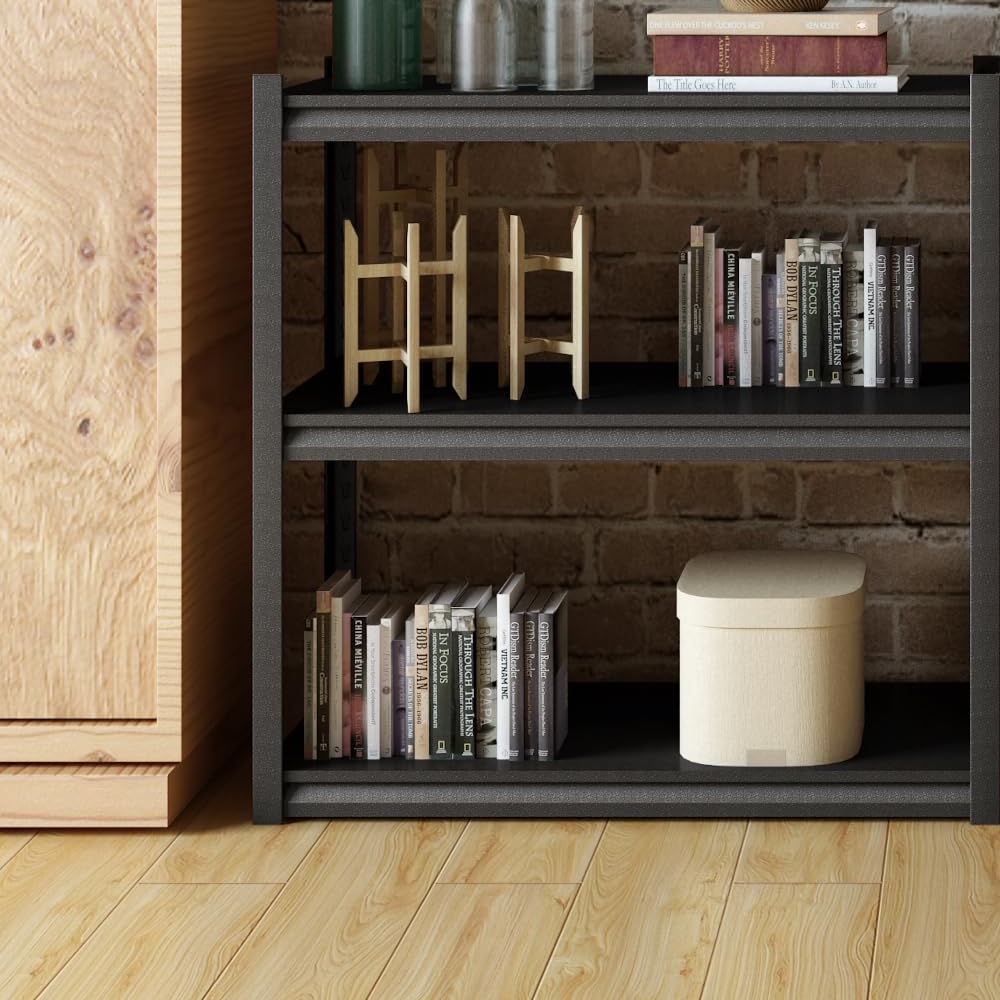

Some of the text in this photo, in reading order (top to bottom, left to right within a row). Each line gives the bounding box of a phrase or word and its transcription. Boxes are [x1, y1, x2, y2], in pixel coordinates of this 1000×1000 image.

[656, 78, 736, 90] The Title Goes Here
[856, 79, 878, 89] Author
[786, 261, 798, 281] BOB
[877, 254, 887, 284] GTDism
[904, 254, 915, 284] GTDism
[727, 253, 737, 319] CHINA MIÉVILLE
[808, 265, 819, 315] IN FOCUS
[867, 281, 875, 315] VIETNAM
[877, 286, 887, 310] Reader
[904, 286, 915, 310] Reader
[786, 286, 798, 321] DYLAN
[831, 267, 842, 366] THROUGH THE LENS
[847, 260, 858, 356] ROBERT CAPA
[416, 627, 428, 649] BOB
[510, 622, 520, 652] GTDism
[539, 622, 550, 652] GTDism
[354, 619, 363, 688] CHINA MIÉVILLE
[438, 632, 449, 683] IN FOCUS
[510, 655, 520, 678] Reader
[539, 655, 550, 678] Reader
[416, 653, 428, 690] DYLAN
[463, 634, 474, 737] THROUGH THE LENS
[479, 626, 492, 728] ROBERT CAPA
